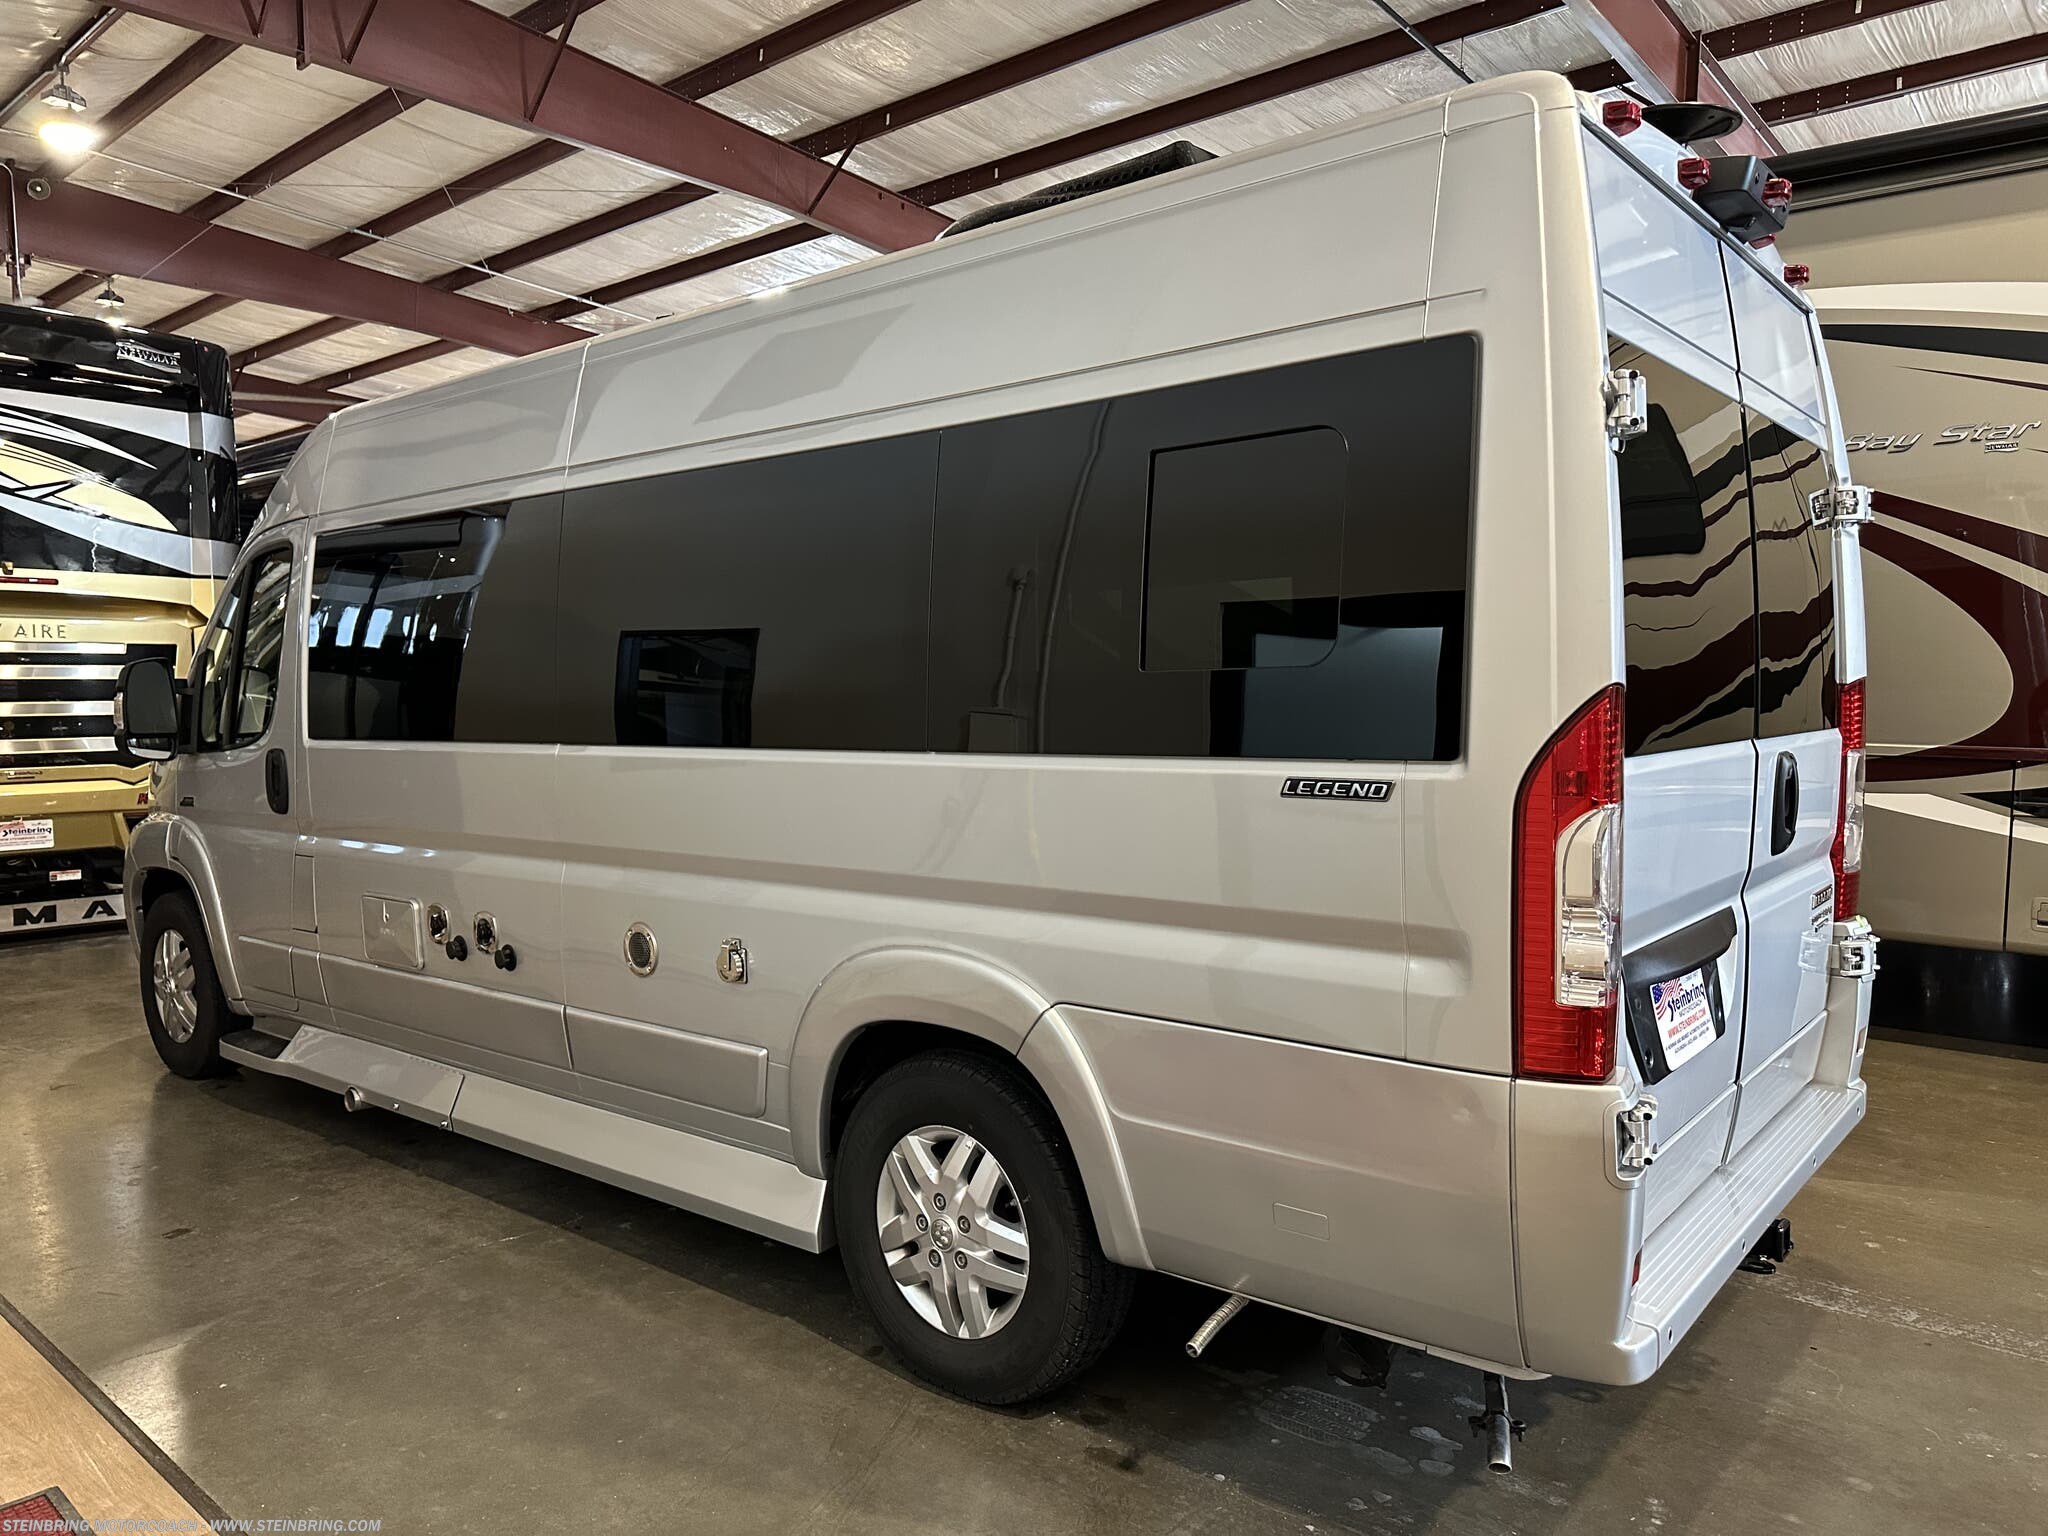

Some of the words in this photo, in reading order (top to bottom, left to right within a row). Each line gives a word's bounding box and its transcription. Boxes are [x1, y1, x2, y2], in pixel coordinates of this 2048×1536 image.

[116, 345, 179, 367] NEWMAR
[1845, 432, 1923, 454] Bay
[1933, 420, 2041, 445] Star
[14, 624, 67, 639] AIRE
[1282, 780, 1389, 798] LEGEND
[1667, 983, 1706, 1022] Steinbring
